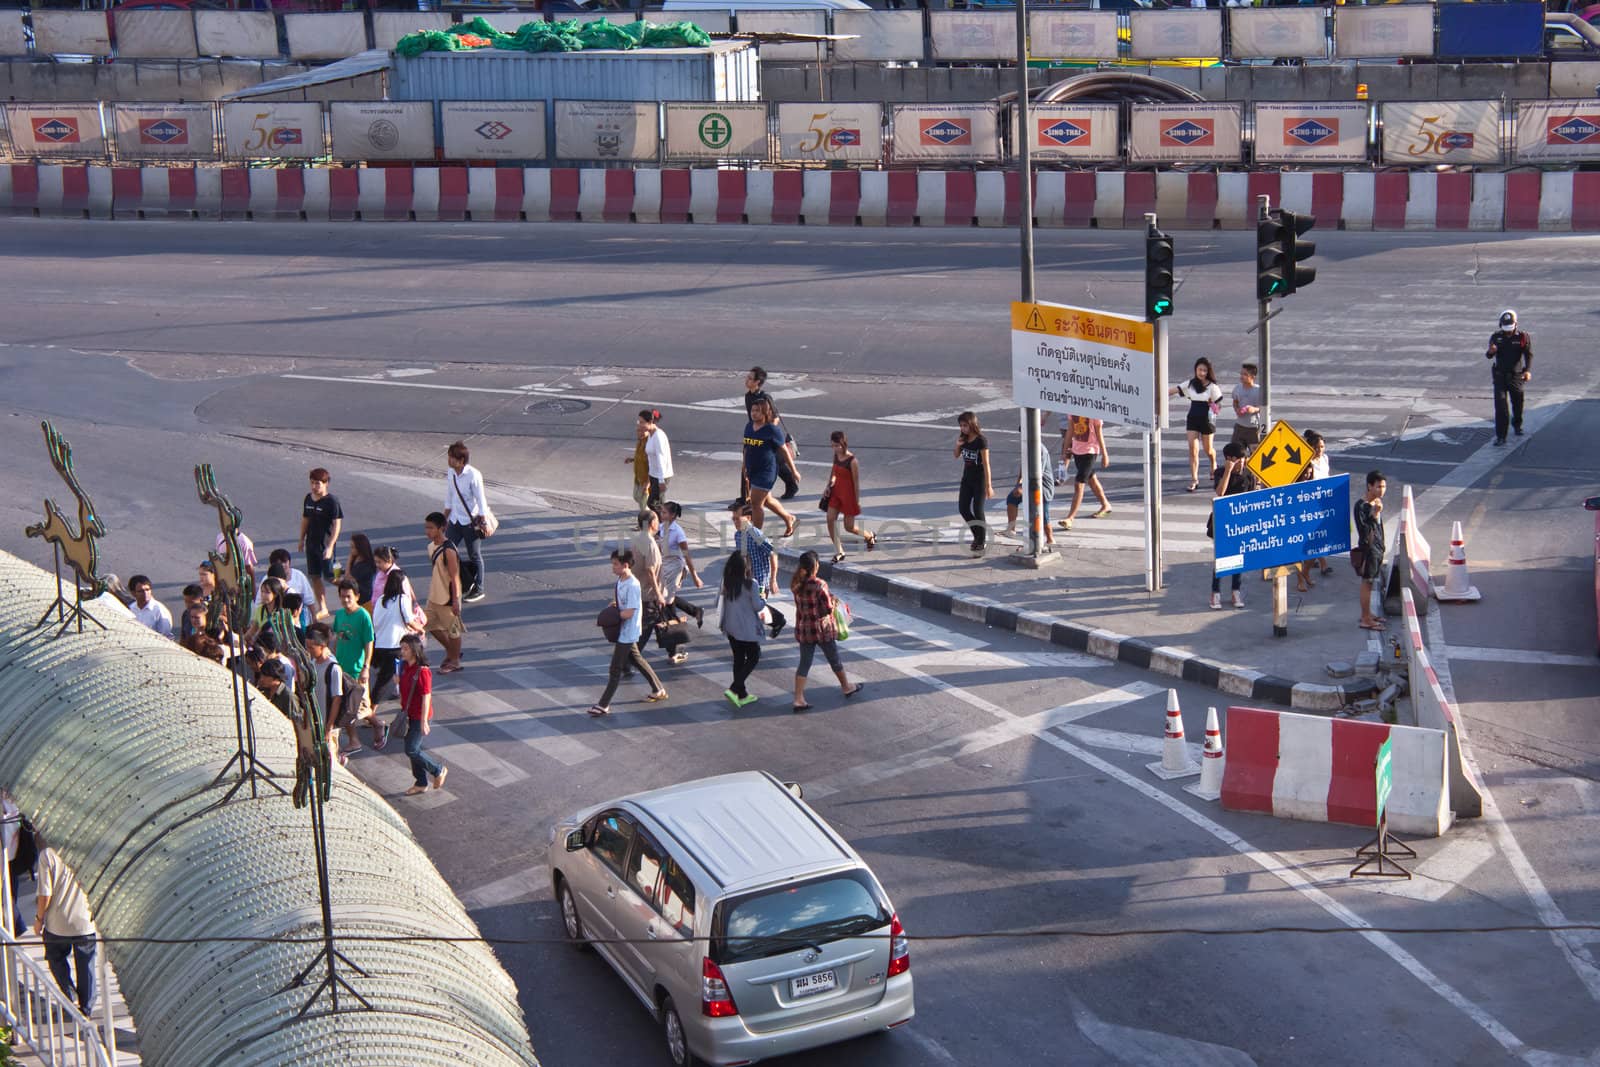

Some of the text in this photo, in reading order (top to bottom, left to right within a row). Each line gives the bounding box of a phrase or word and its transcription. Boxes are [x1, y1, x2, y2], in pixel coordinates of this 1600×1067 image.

[929, 128, 962, 136] SINO-THAI
[1047, 128, 1081, 136] SINO-THAI
[1170, 129, 1203, 137] SINO-THAI
[1293, 128, 1328, 136] SINO-THAI
[1558, 126, 1596, 135] SINO-THAI
[1054, 315, 1136, 344] ระวังอันตราย
[1036, 342, 1131, 372] เกิดอุบัติเหตุบ่อยครั้ง
[1027, 367, 1140, 396] กรุณารอสัญญาณไฟแดง
[1039, 387, 1130, 416] ก่อนข้ามทางม้าลาย
[742, 437, 765, 447] STAFF
[1229, 486, 1333, 515] ไปท่าพระใช้ 2 ช่องซ้าย
[1225, 508, 1336, 537] ไปนครปฐมใช้ 3 ช่องขวา
[1239, 529, 1328, 554] ฝ่าฝืนปรับ 400 บาท
[812, 972, 833, 984] 5856
